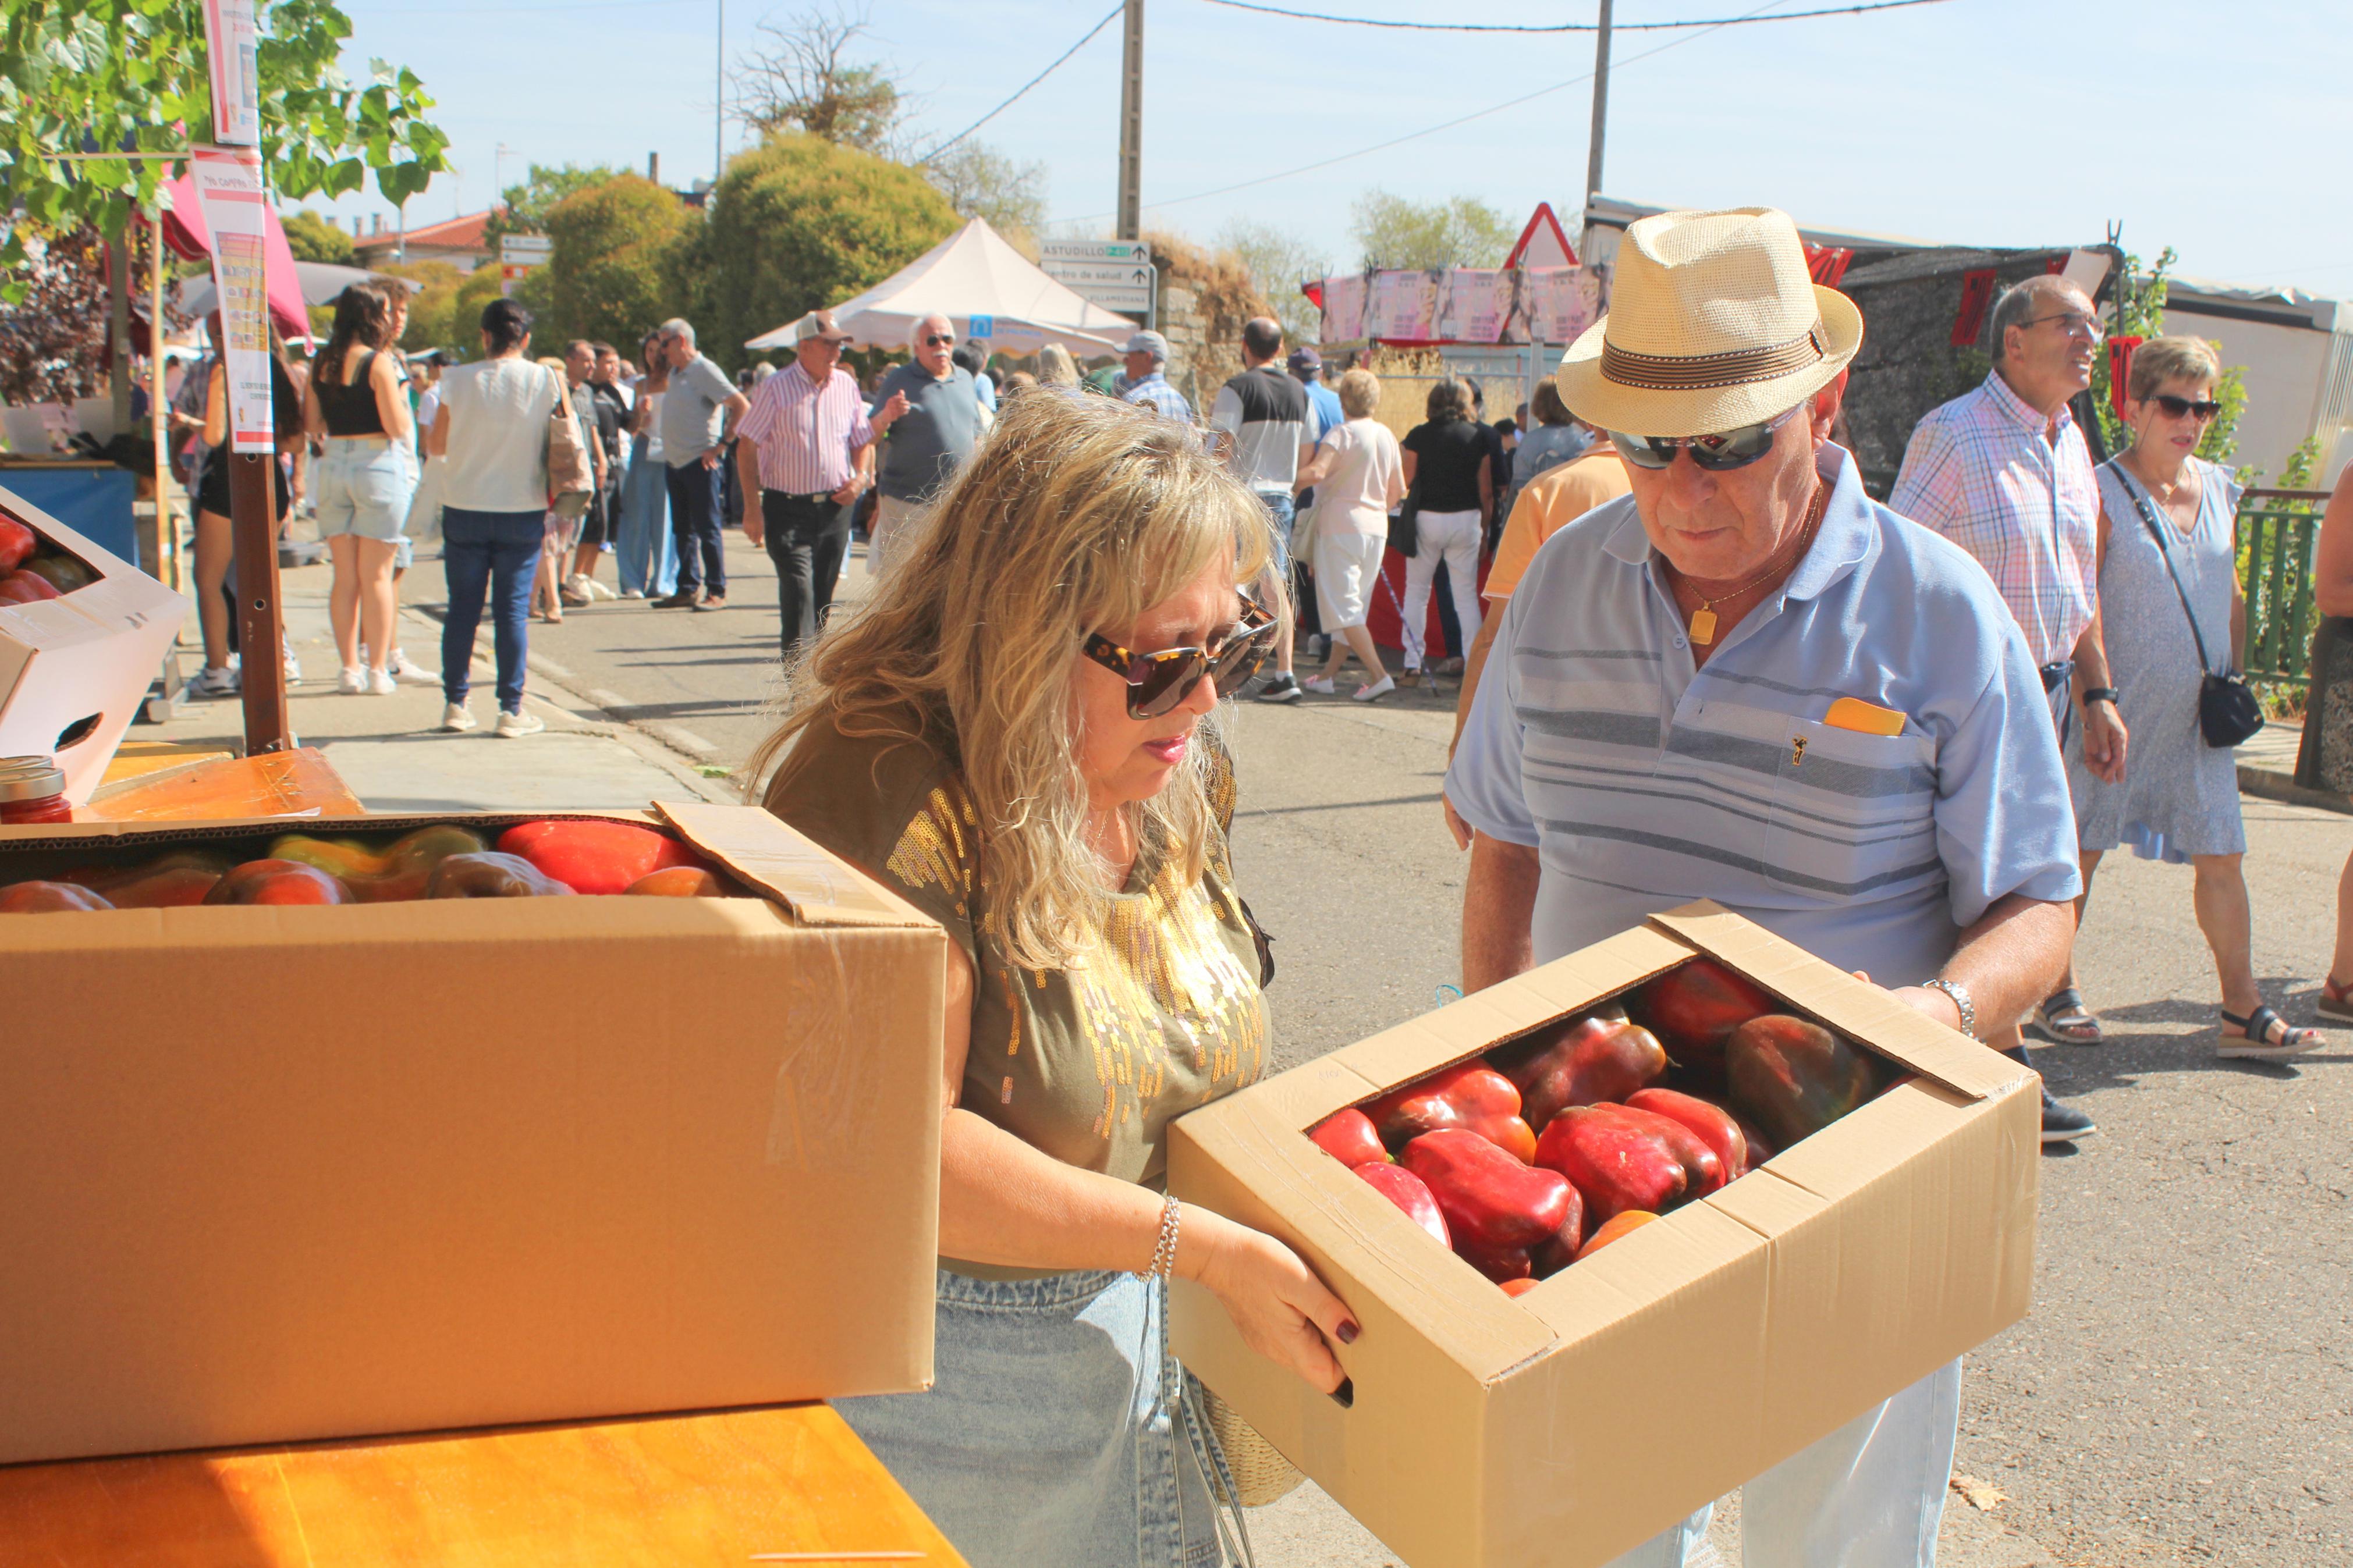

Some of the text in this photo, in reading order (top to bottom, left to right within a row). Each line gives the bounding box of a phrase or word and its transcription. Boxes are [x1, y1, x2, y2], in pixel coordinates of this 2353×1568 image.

[1044, 246, 1104, 256] ASTUDILLO
[1080, 271, 1091, 279] de
[1096, 271, 1122, 280] salud
[1089, 295, 1145, 303] VILLAMEDIANA
